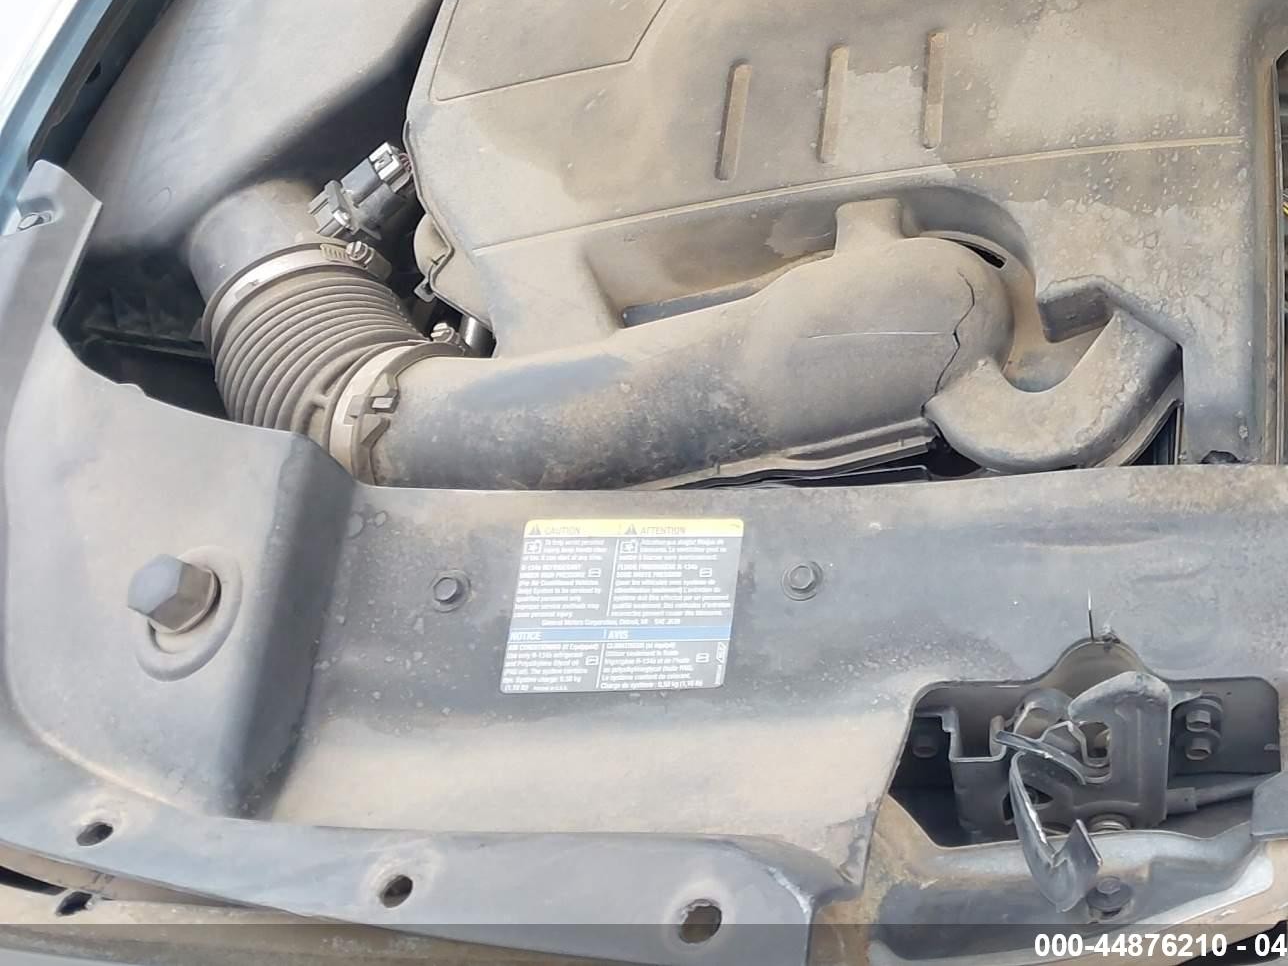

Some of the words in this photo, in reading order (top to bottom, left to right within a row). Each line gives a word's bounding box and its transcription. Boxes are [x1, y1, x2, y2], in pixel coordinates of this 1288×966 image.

[544, 526, 581, 535] CAUTION
[640, 525, 687, 535] ATTENTION
[510, 631, 542, 641] NOTICE
[607, 630, 629, 640] AVIS
